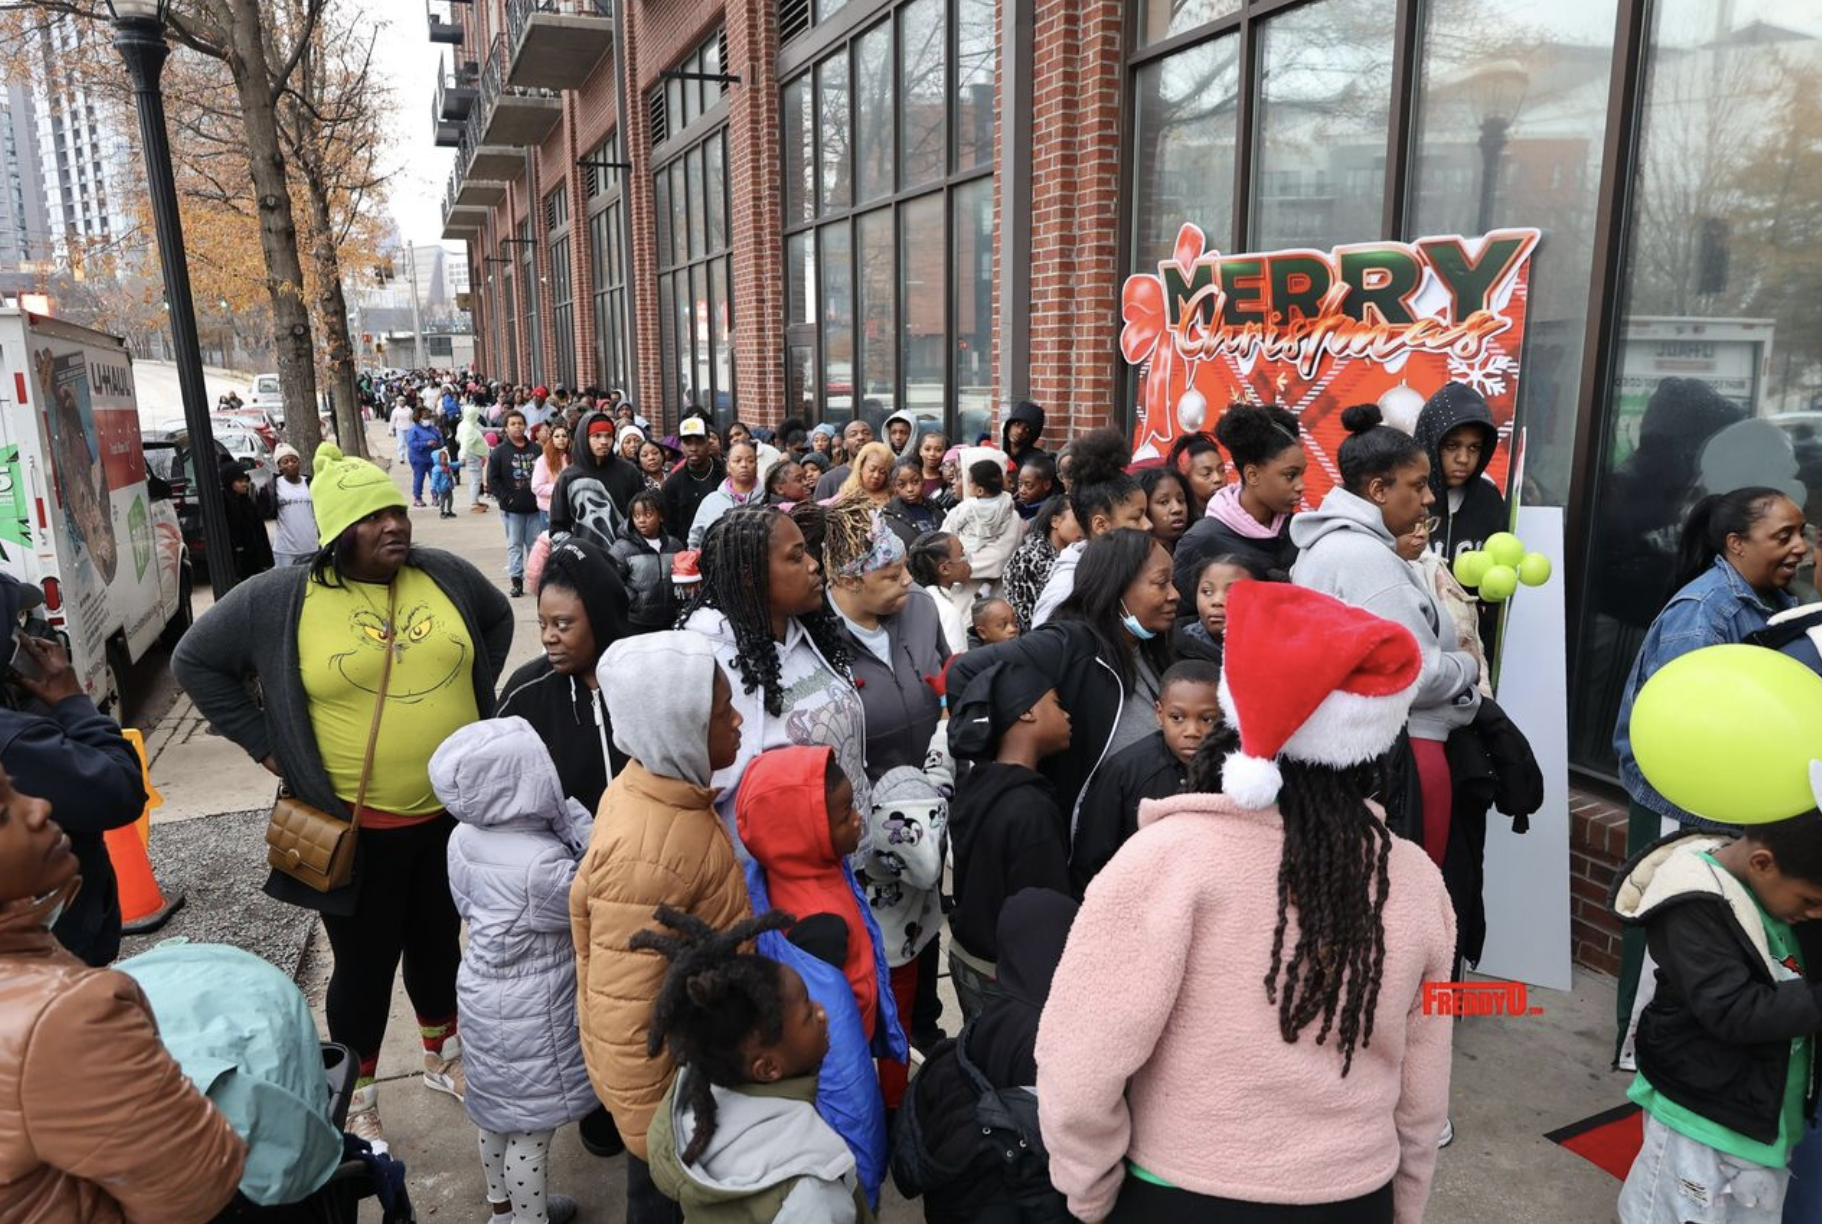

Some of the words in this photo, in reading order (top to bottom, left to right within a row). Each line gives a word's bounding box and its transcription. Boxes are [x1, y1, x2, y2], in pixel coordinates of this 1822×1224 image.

[1161, 229, 1538, 327] MERRY
[1172, 281, 1509, 377] Christmas
[90, 361, 133, 397] U-HAUL
